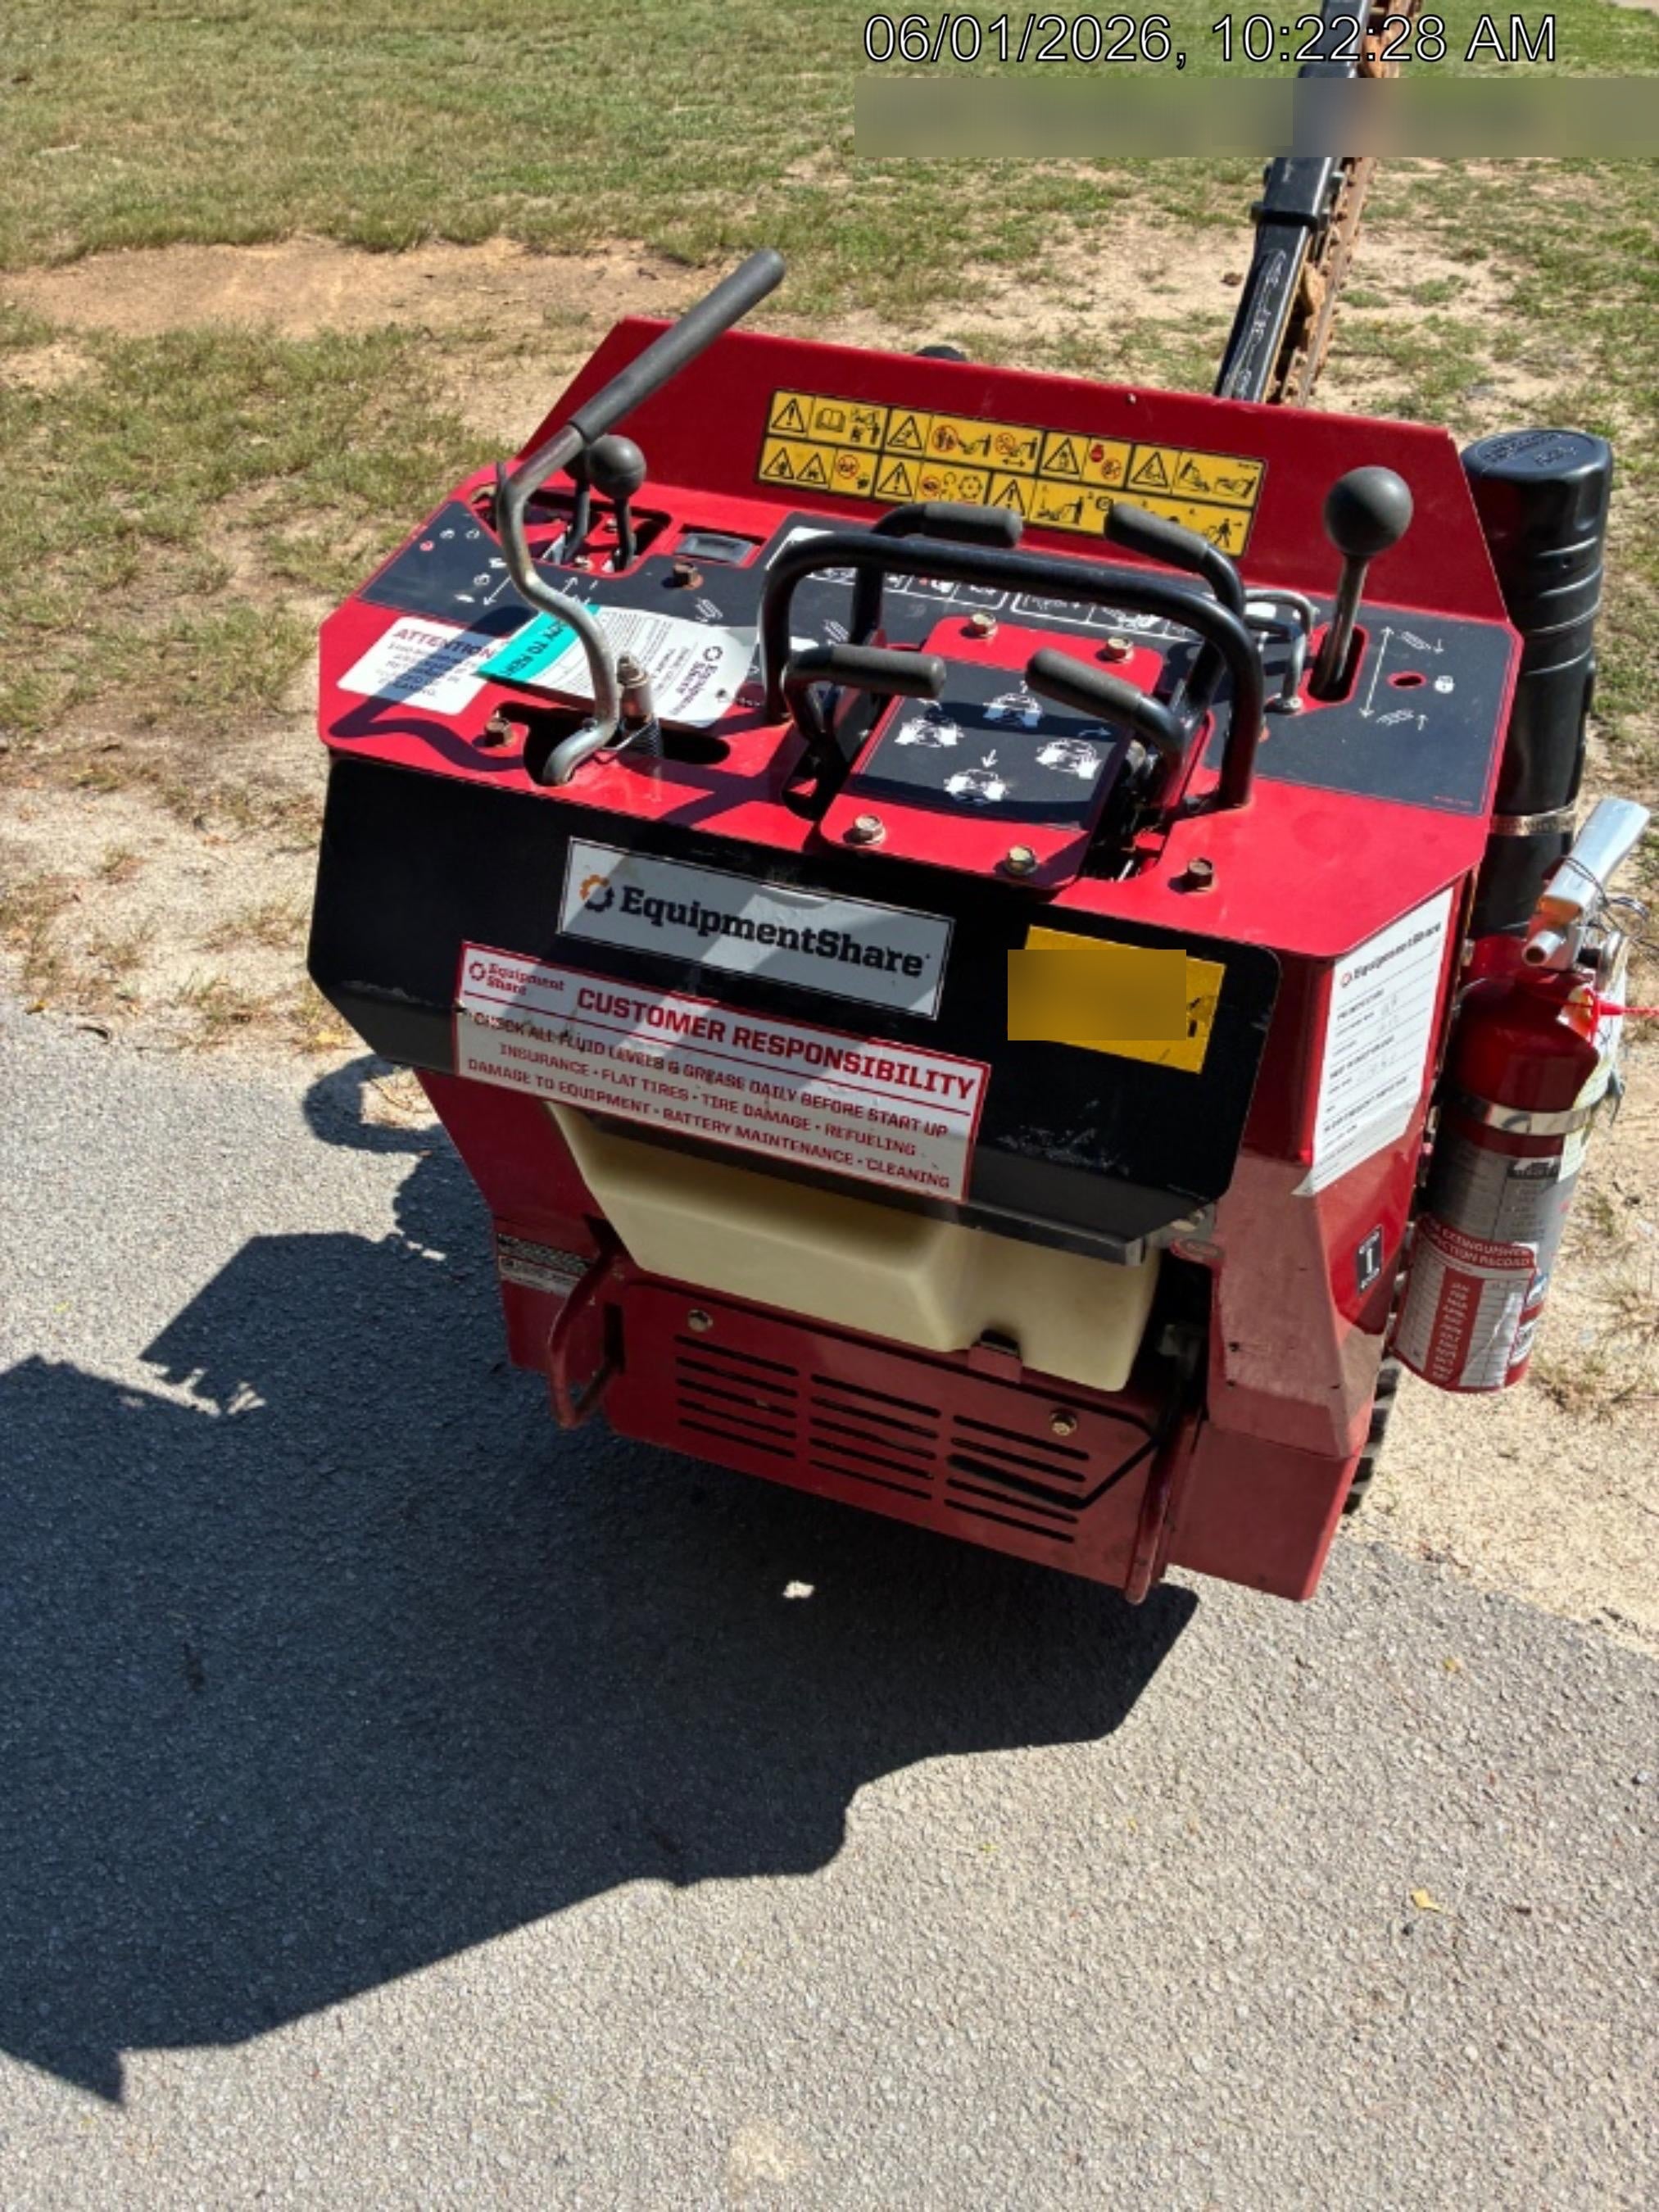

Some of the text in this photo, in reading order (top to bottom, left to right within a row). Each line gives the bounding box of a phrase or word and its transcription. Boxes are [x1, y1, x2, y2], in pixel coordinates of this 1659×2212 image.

[392, 628, 497, 659] ATTENTION
[487, 962, 564, 993] Equipment
[619, 886, 925, 977] EquipmentShare
[486, 973, 527, 996] Share
[559, 1031, 605, 1056] FLUID
[682, 1062, 744, 1090] GREASE
[749, 1078, 798, 1103] DAILY
[800, 1090, 864, 1119] BEFORE
[867, 1107, 921, 1133] START
[922, 1121, 949, 1140] UP
[576, 986, 976, 1104] CUSTOMER RESPONSIBILITY
[468, 1058, 950, 1191] DAMAGE TO EQUIPMENT BATTERY MAINTENANCE CLEANING
[499, 1042, 917, 1158] INSURANCE FLAT TIRES TIRE DAMAGE REFUELING
